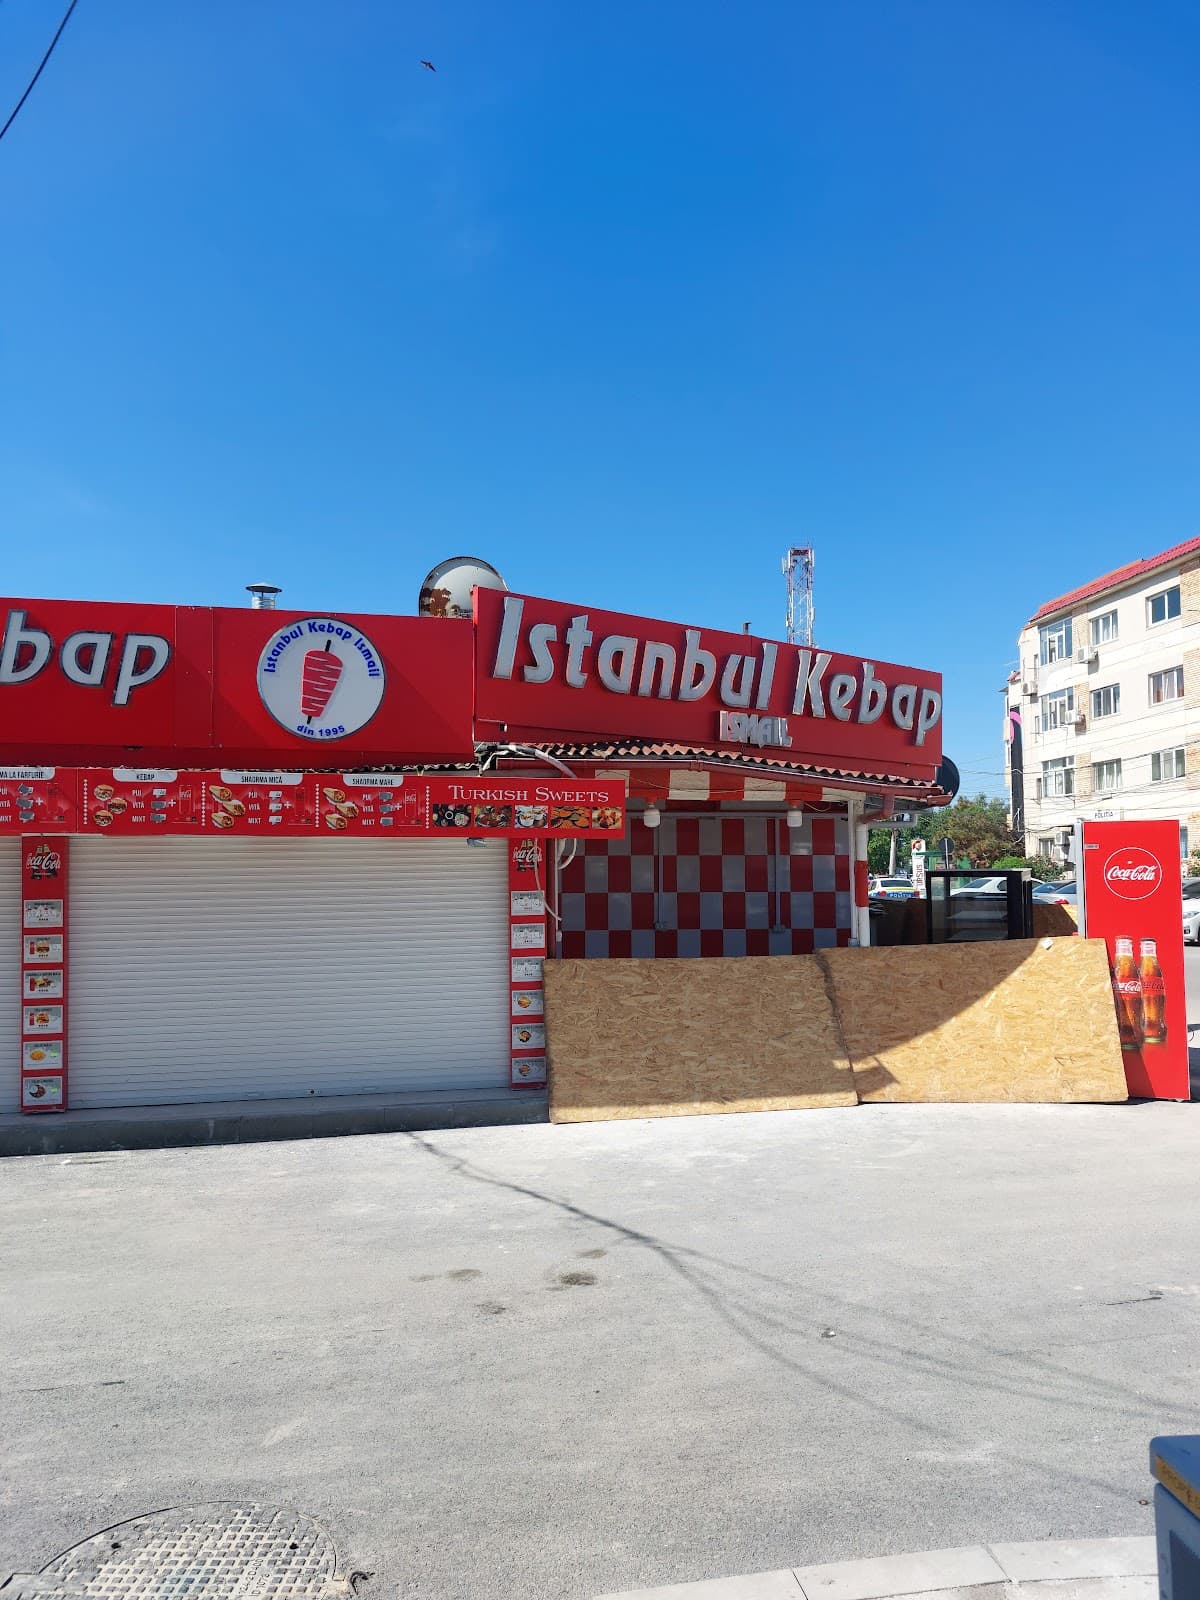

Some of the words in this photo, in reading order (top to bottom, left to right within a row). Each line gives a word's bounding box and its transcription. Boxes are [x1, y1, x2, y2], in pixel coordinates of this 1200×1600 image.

[264, 625, 304, 673] Istanbul
[307, 621, 353, 641] Kebap
[353, 637, 380, 677] Ismail
[493, 596, 778, 711] Istanbul
[792, 649, 942, 747] Kebap
[296, 724, 315, 736] din
[318, 725, 345, 737] 1995
[136, 773, 155, 781] KEBAP
[447, 785, 529, 801] TURKISH
[535, 787, 609, 803] SWEETS
[1107, 865, 1158, 881] Coca-Cola
